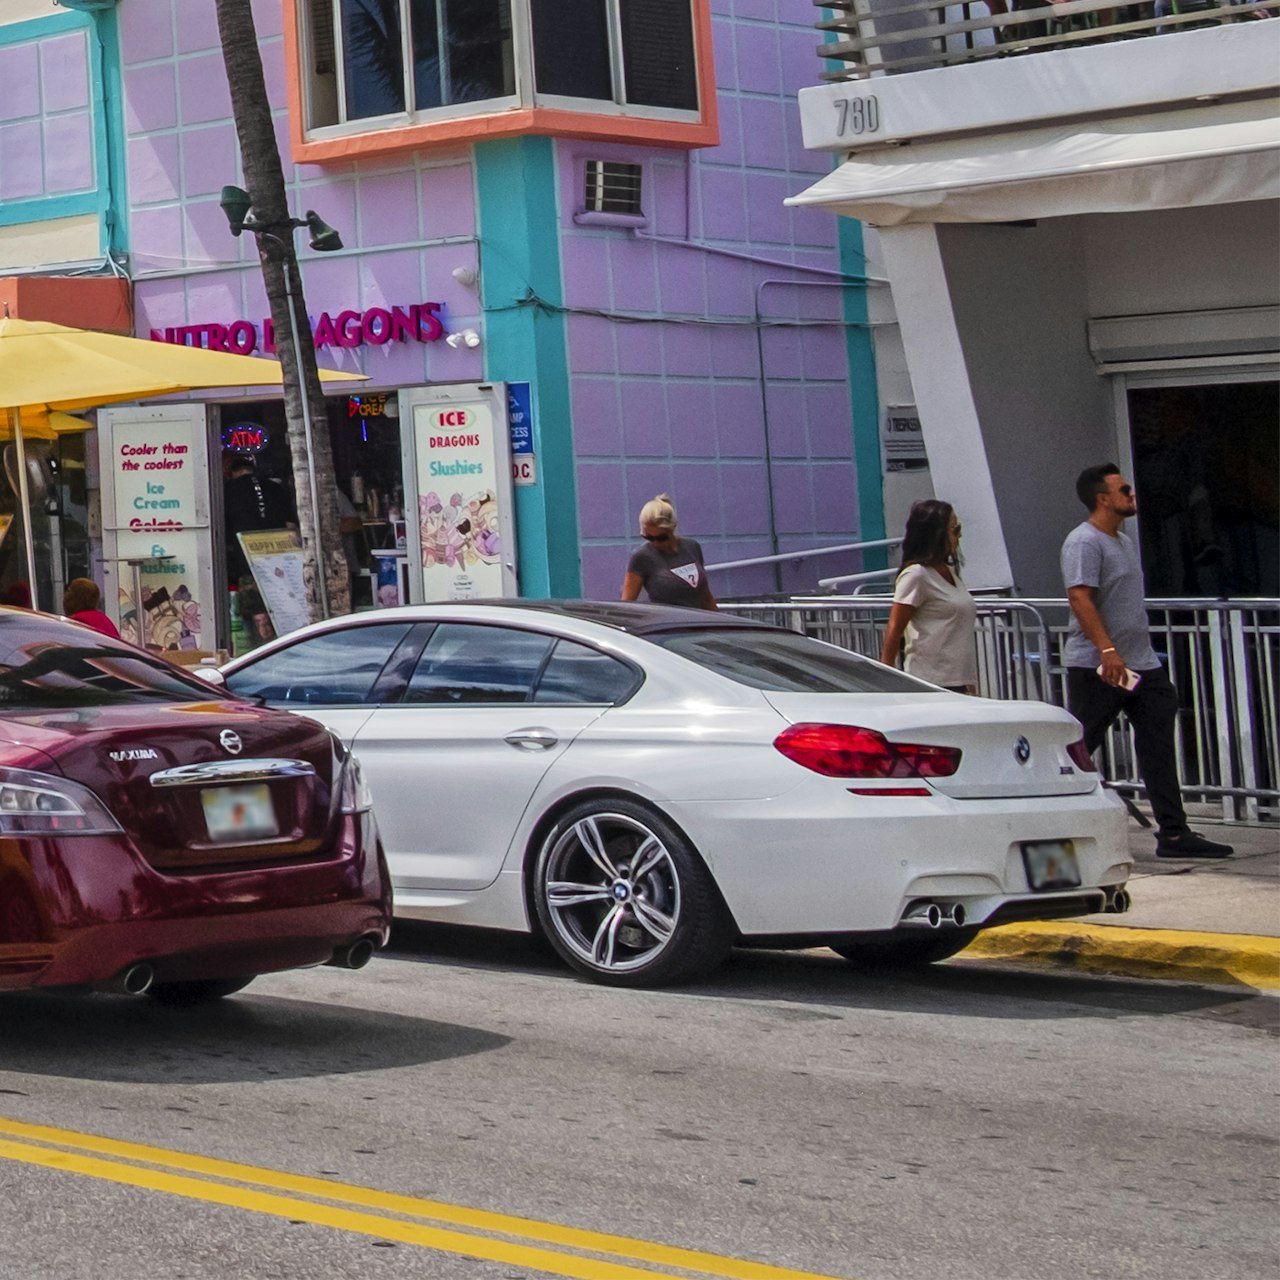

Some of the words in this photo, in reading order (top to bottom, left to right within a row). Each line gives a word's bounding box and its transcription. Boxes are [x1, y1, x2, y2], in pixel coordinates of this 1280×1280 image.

[264, 302, 444, 353] DAGONS
[440, 411, 466, 427] ICE
[231, 431, 262, 447] ATM
[429, 434, 480, 448] DRAGONS
[120, 443, 157, 456] Cooler
[162, 442, 188, 454] than
[122, 459, 140, 471] the
[144, 457, 184, 470] coolest
[429, 459, 483, 477] Slushies
[146, 481, 166, 495] Ice
[133, 497, 180, 510] Cream
[129, 518, 184, 533] Gelato
